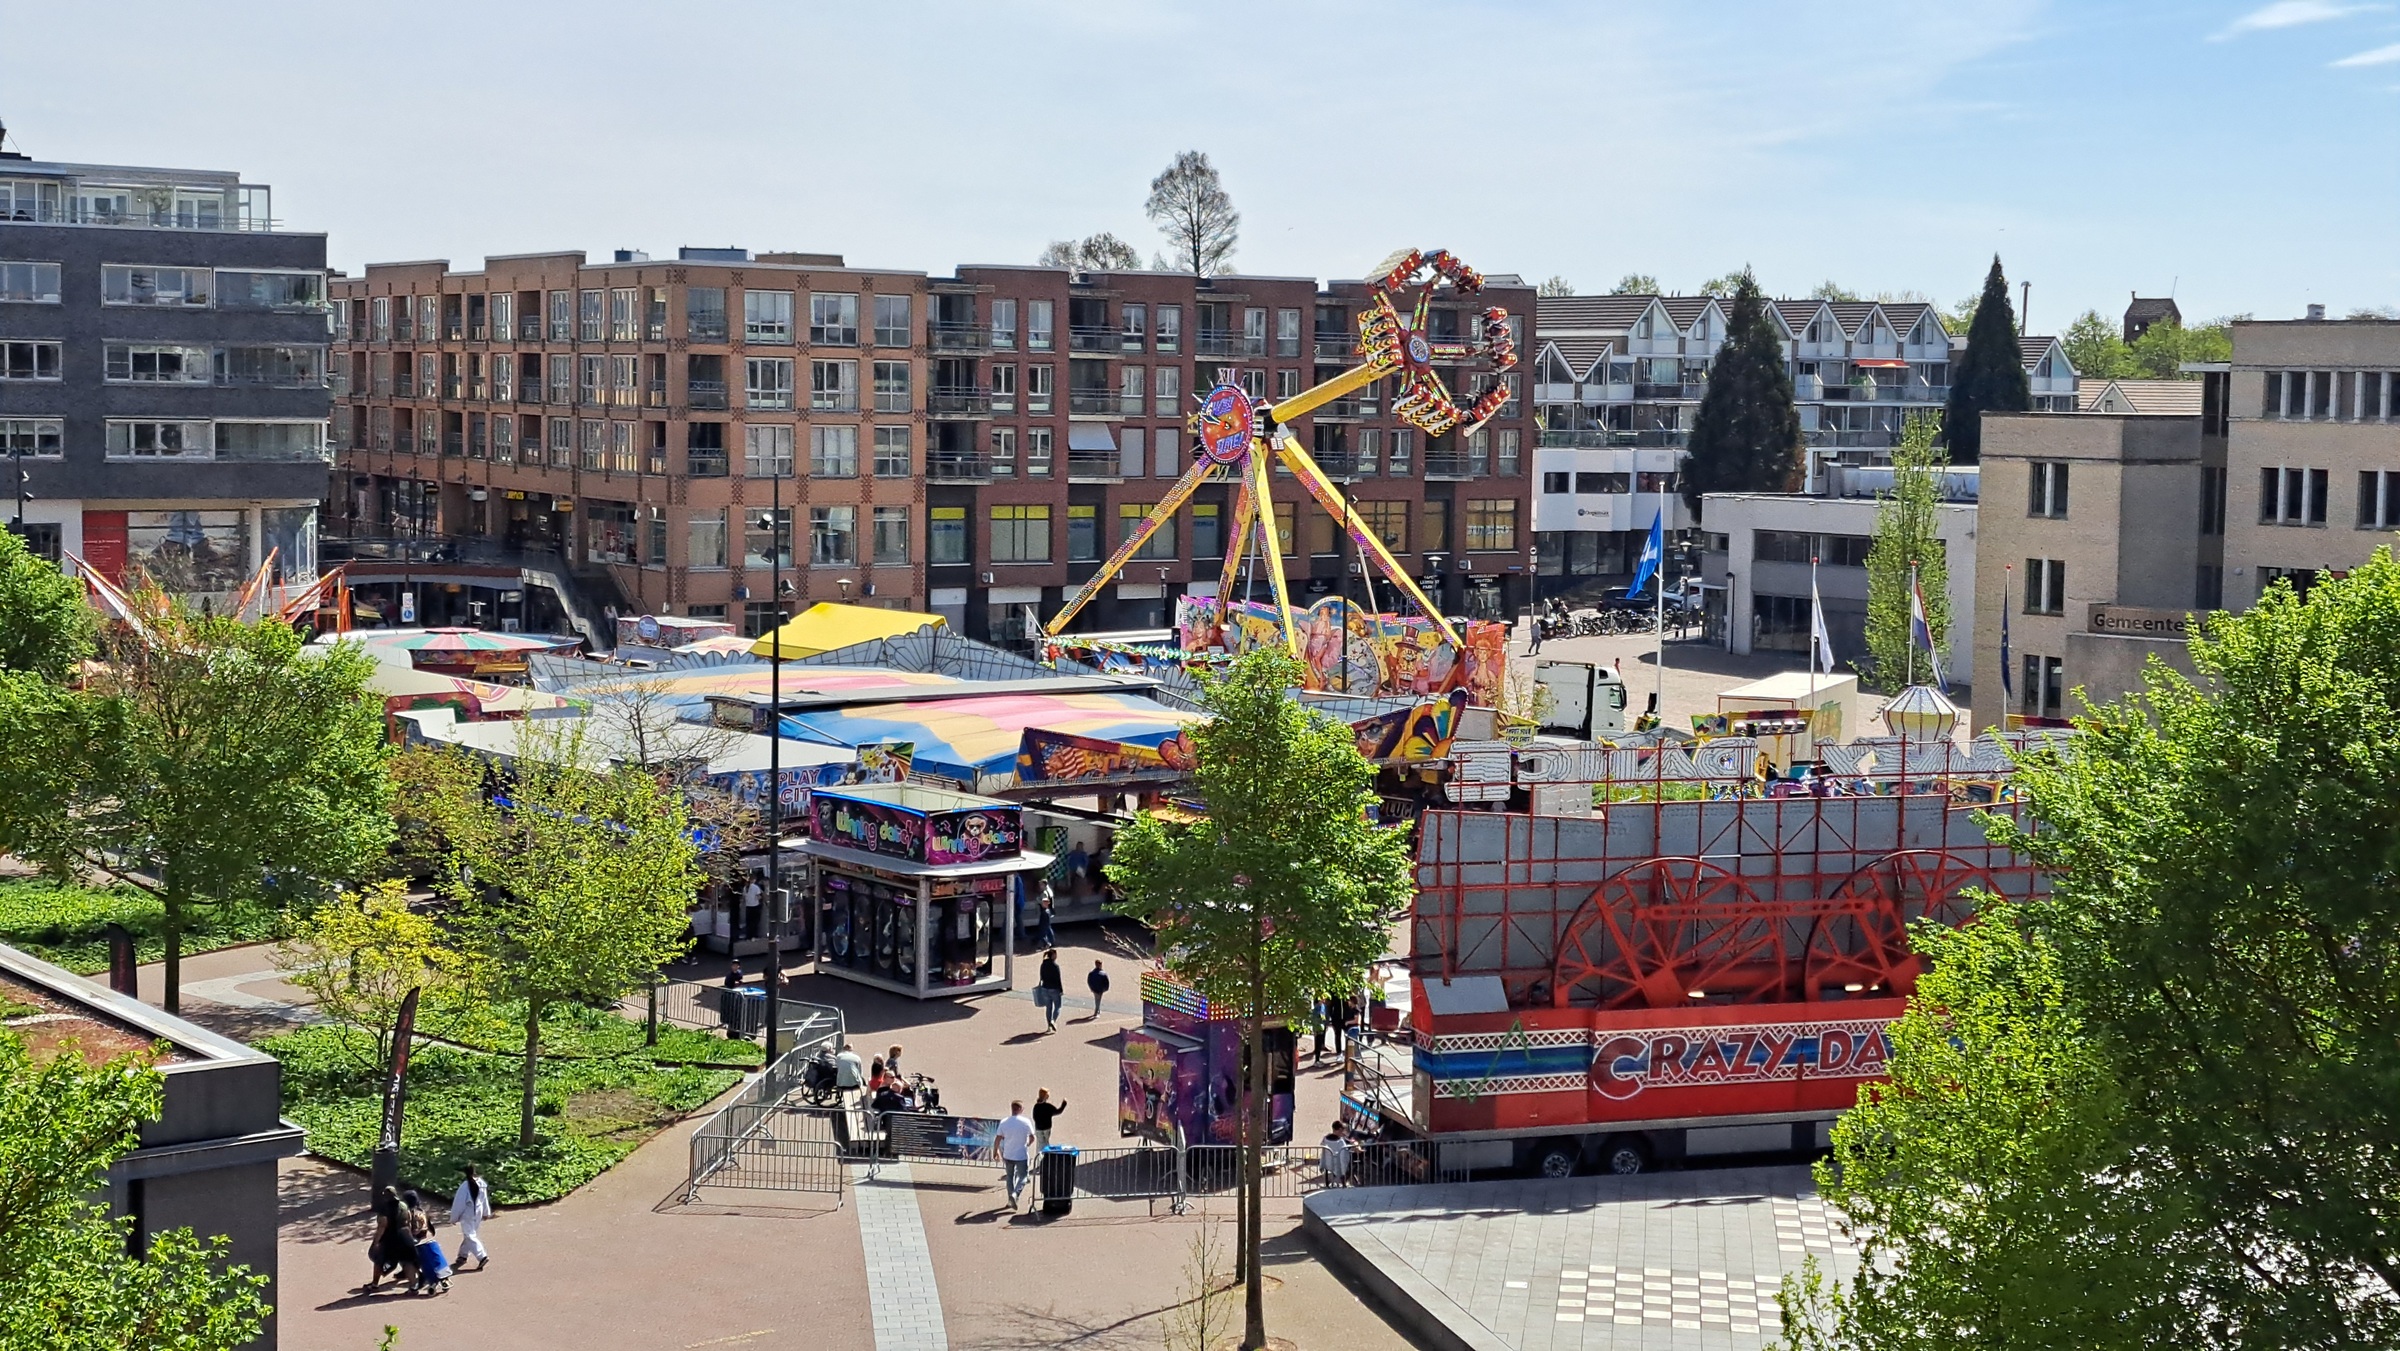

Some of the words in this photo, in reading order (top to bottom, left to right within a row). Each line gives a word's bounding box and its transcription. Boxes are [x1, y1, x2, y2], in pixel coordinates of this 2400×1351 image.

[778, 769, 820, 787] PLAY
[780, 787, 812, 805] CIT
[1592, 1029, 1796, 1100] CRAZY
